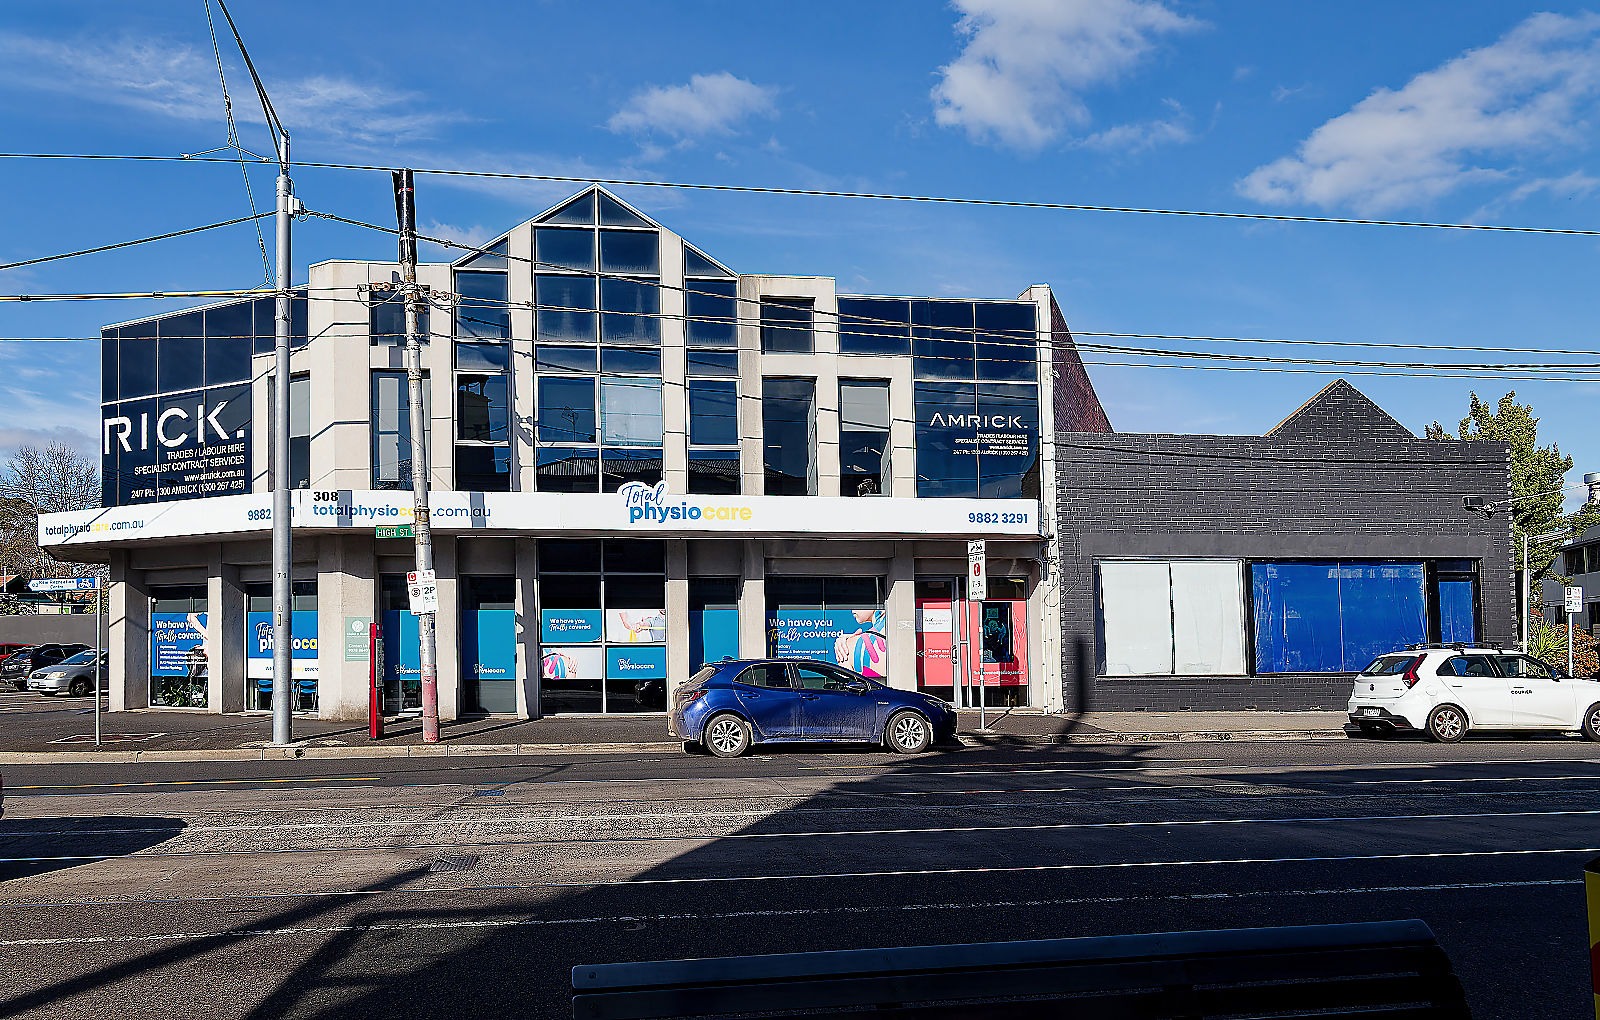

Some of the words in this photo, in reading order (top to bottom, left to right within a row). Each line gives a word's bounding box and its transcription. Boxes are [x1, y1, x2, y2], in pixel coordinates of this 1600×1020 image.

[929, 412, 1029, 429] AMRICK.
[167, 448, 194, 460] TRADES
[198, 445, 226, 457] LABOUR
[227, 443, 245, 453] HIRE
[134, 463, 172, 475] SPECIALIST
[171, 459, 209, 471] CONTRACT
[209, 454, 245, 467] SERVICES
[184, 469, 245, 482] www.amrick.com.au
[170, 483, 198, 495] AMRICK
[216, 480, 229, 491] 267
[229, 479, 246, 490] 425)
[313, 491, 339, 502] 308
[621, 483, 665, 507] Total
[247, 507, 272, 521] 9882
[312, 504, 491, 520] totalphysioca.com.au
[629, 502, 753, 524] physiocare
[968, 512, 999, 524] 9882
[1001, 513, 1028, 524] 3291
[44, 518, 144, 537] totalphysiocare.com.au
[377, 528, 397, 537] HIGH
[399, 528, 409, 537] ST
[424, 586, 436, 595] 2P
[156, 620, 168, 629] We
[168, 620, 185, 629] have
[574, 618, 586, 627] you
[769, 618, 786, 627] We
[787, 618, 813, 628] have
[813, 619, 833, 630] you
[255, 622, 274, 641] Tota
[767, 628, 801, 642] Totally
[802, 630, 844, 639] covered
